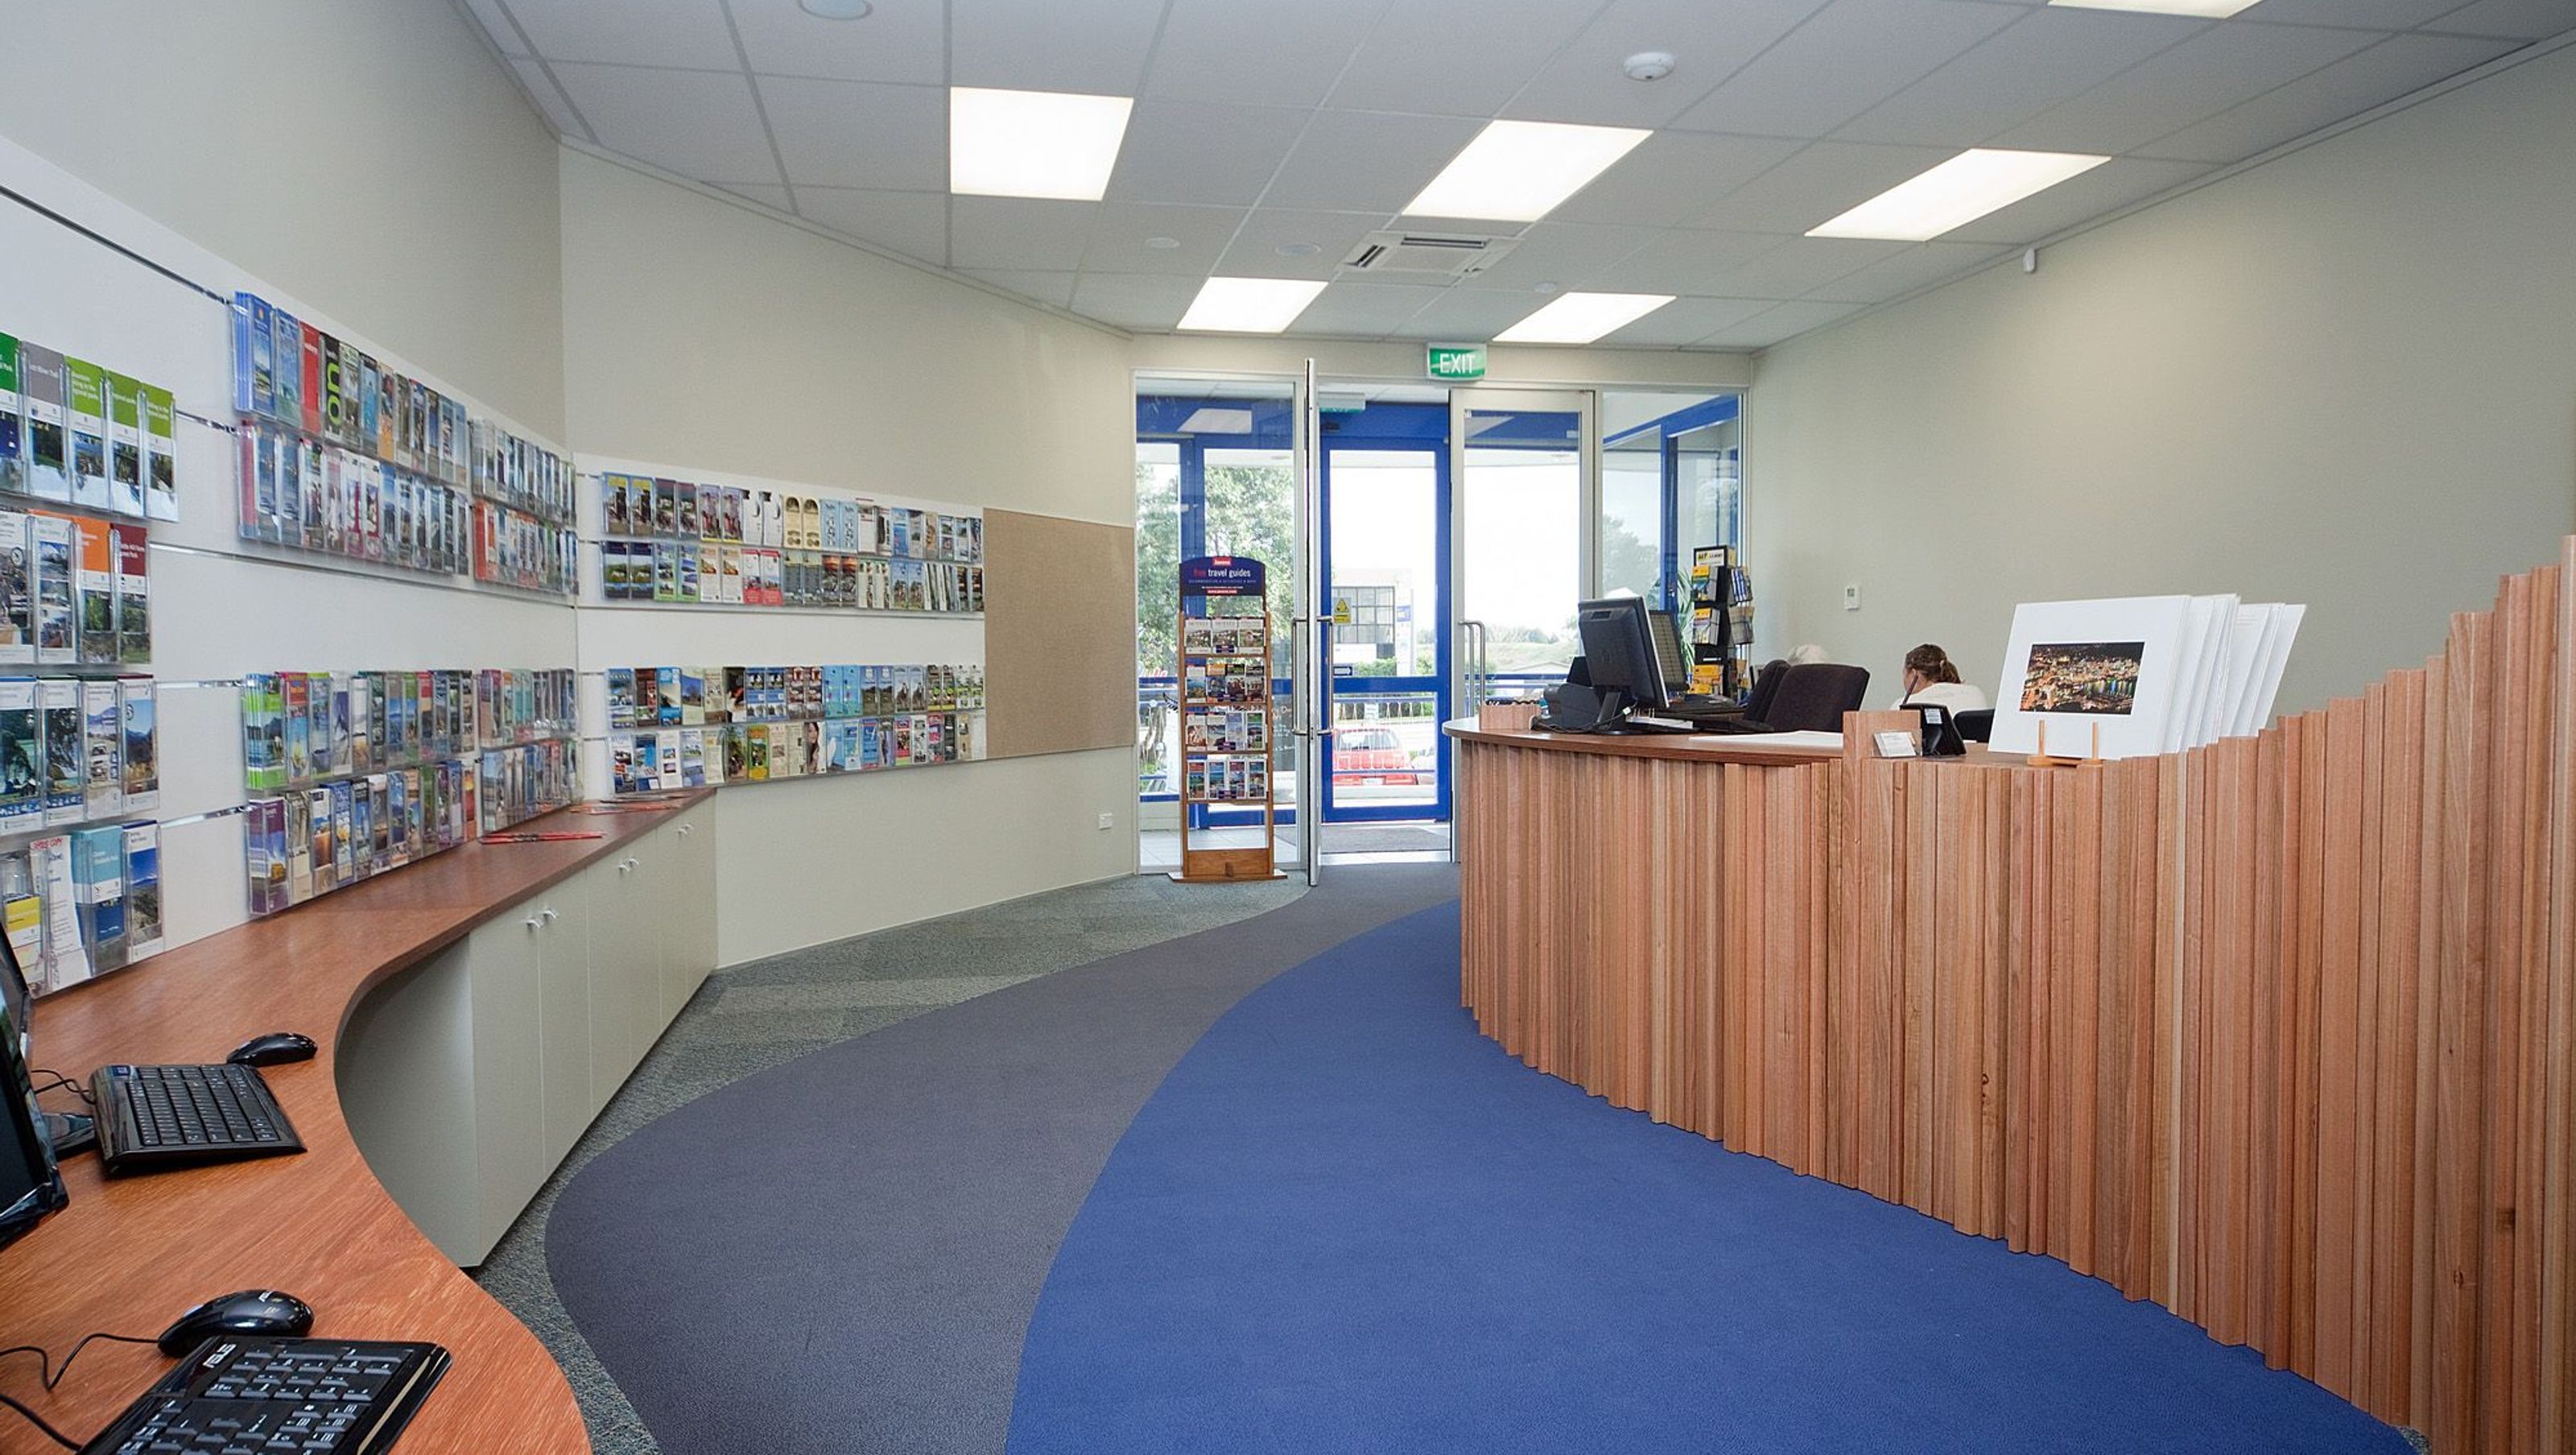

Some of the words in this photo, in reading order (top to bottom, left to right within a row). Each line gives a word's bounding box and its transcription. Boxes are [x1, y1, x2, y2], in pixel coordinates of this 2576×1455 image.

[1439, 353, 1476, 374] EXIT
[1208, 568, 1228, 577] travel
[1228, 568, 1250, 578] guides
